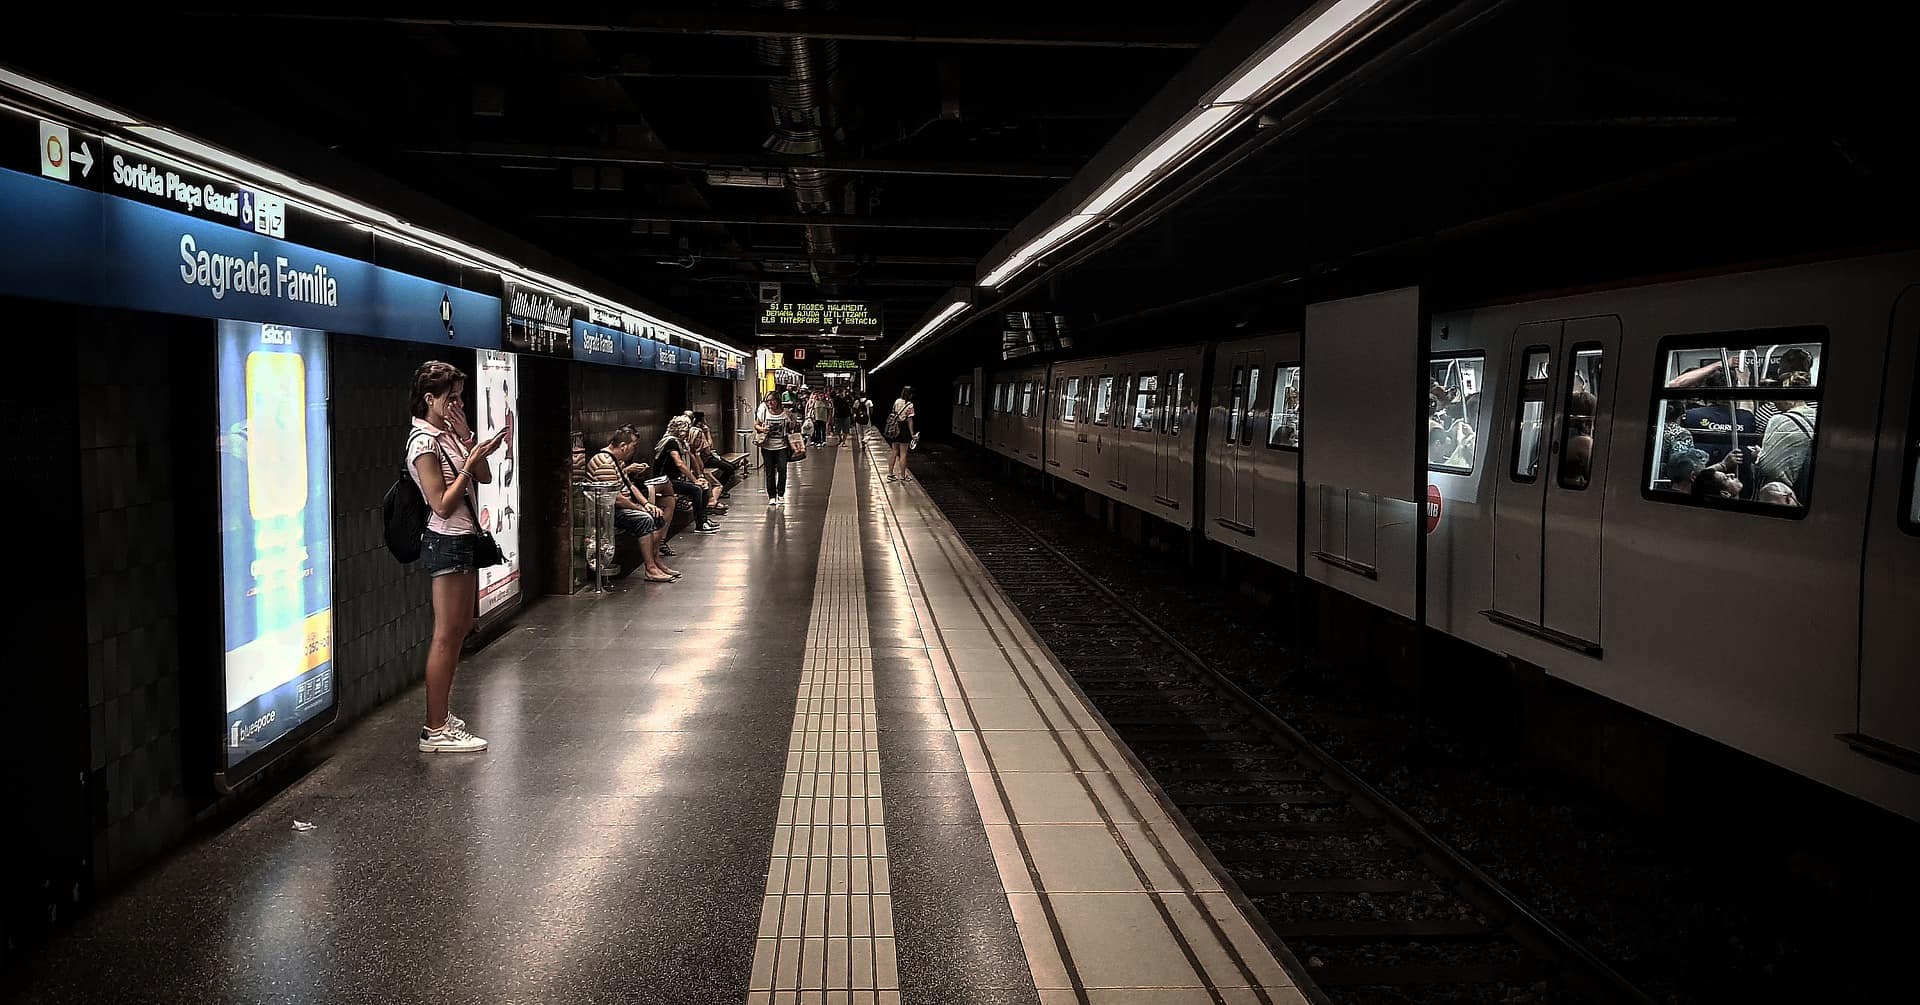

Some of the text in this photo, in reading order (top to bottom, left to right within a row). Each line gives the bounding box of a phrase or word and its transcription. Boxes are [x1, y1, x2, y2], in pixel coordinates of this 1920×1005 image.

[113, 155, 239, 217] Sortida Plaça Gaudí
[180, 233, 338, 306] Sagrada Família
[240, 710, 276, 741] bluespace
